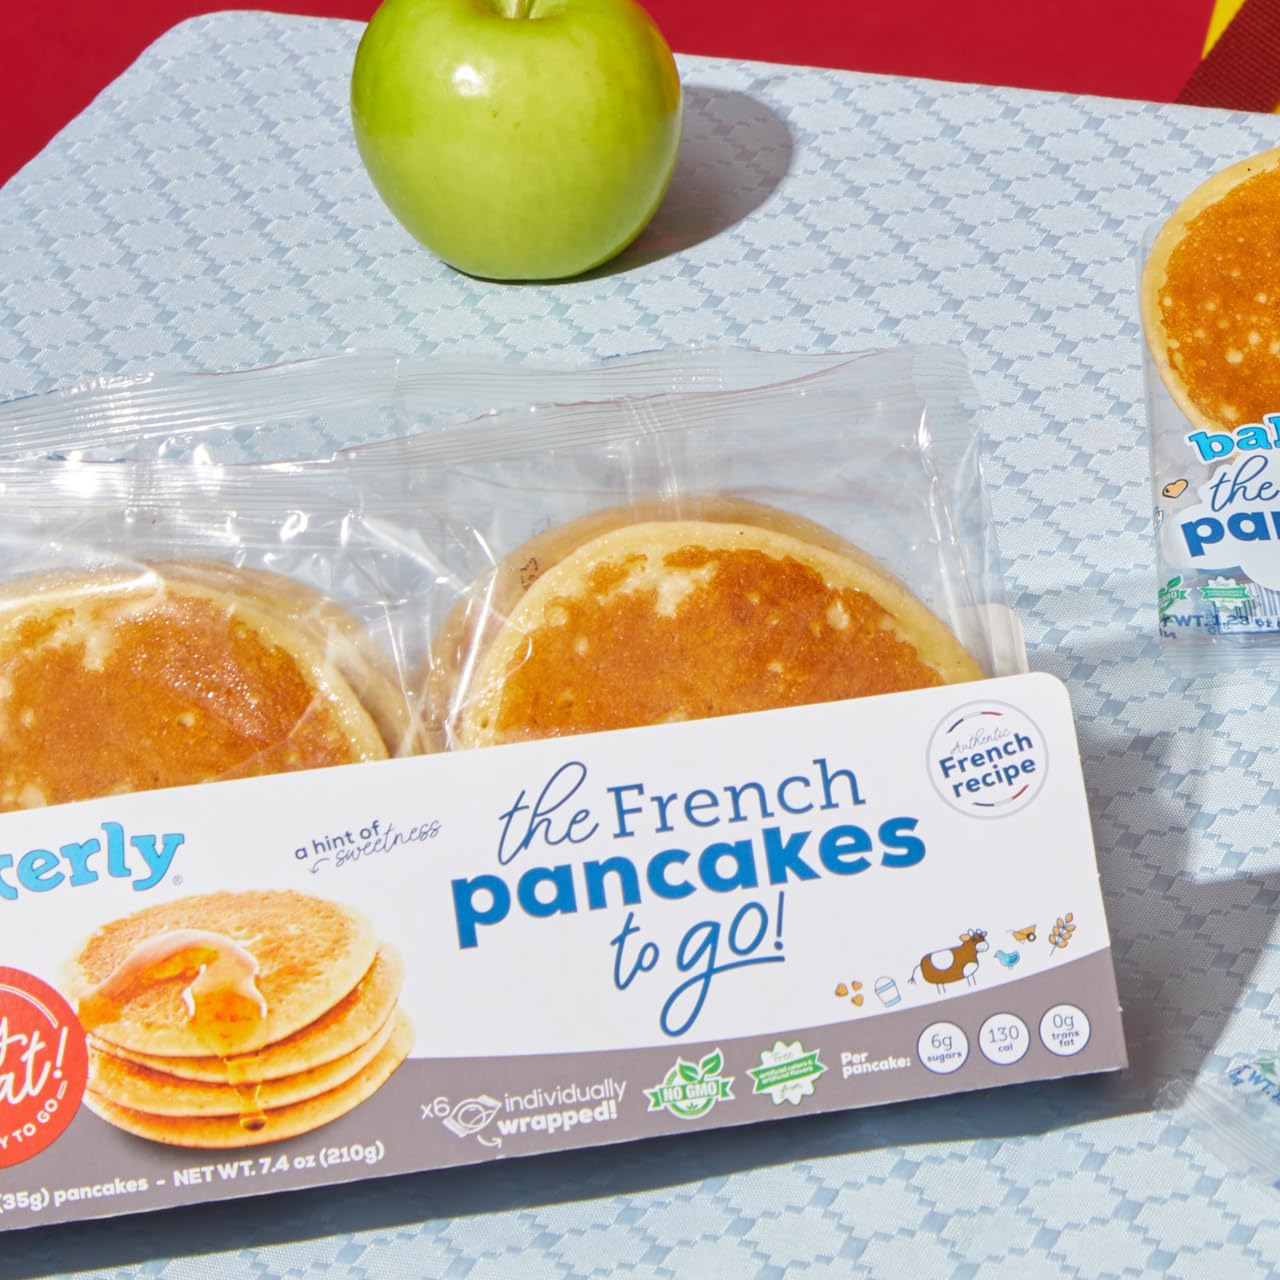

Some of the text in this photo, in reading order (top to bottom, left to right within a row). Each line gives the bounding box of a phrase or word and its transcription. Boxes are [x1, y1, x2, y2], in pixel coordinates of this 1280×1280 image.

[1210, 454, 1280, 513] the
[939, 733, 1033, 778] French
[950, 727, 1010, 754] Authentic
[952, 758, 1036, 798] recipe
[498, 757, 866, 866] the French
[295, 819, 380, 860] a hint of
[336, 819, 442, 868] sweetness
[451, 816, 926, 950] pancakes
[610, 890, 786, 1038] to go!
[989, 1025, 1020, 1044] 130
[1052, 1013, 1075, 1031] 0g
[1052, 1030, 1080, 1041] trans
[840, 1051, 868, 1066] Per
[927, 1051, 962, 1064] sugars
[931, 1033, 953, 1051] 6g
[998, 1042, 1013, 1052] cal
[1059, 1038, 1075, 1048] fat
[843, 1056, 912, 1079] pancake:
[420, 1077, 627, 1120] x6 individually
[662, 1080, 718, 1103] NO GMO
[12, 1122, 37, 1143] TO
[37, 1098, 59, 1124] GO
[497, 1099, 619, 1135] wrapped!
[54, 1177, 148, 1208] pancakes
[173, 1166, 214, 1187] NET
[215, 1160, 255, 1181] WT.
[257, 1154, 290, 1175] 7.4
[293, 1154, 316, 1170] oz
[319, 1140, 385, 1168] (210g)
